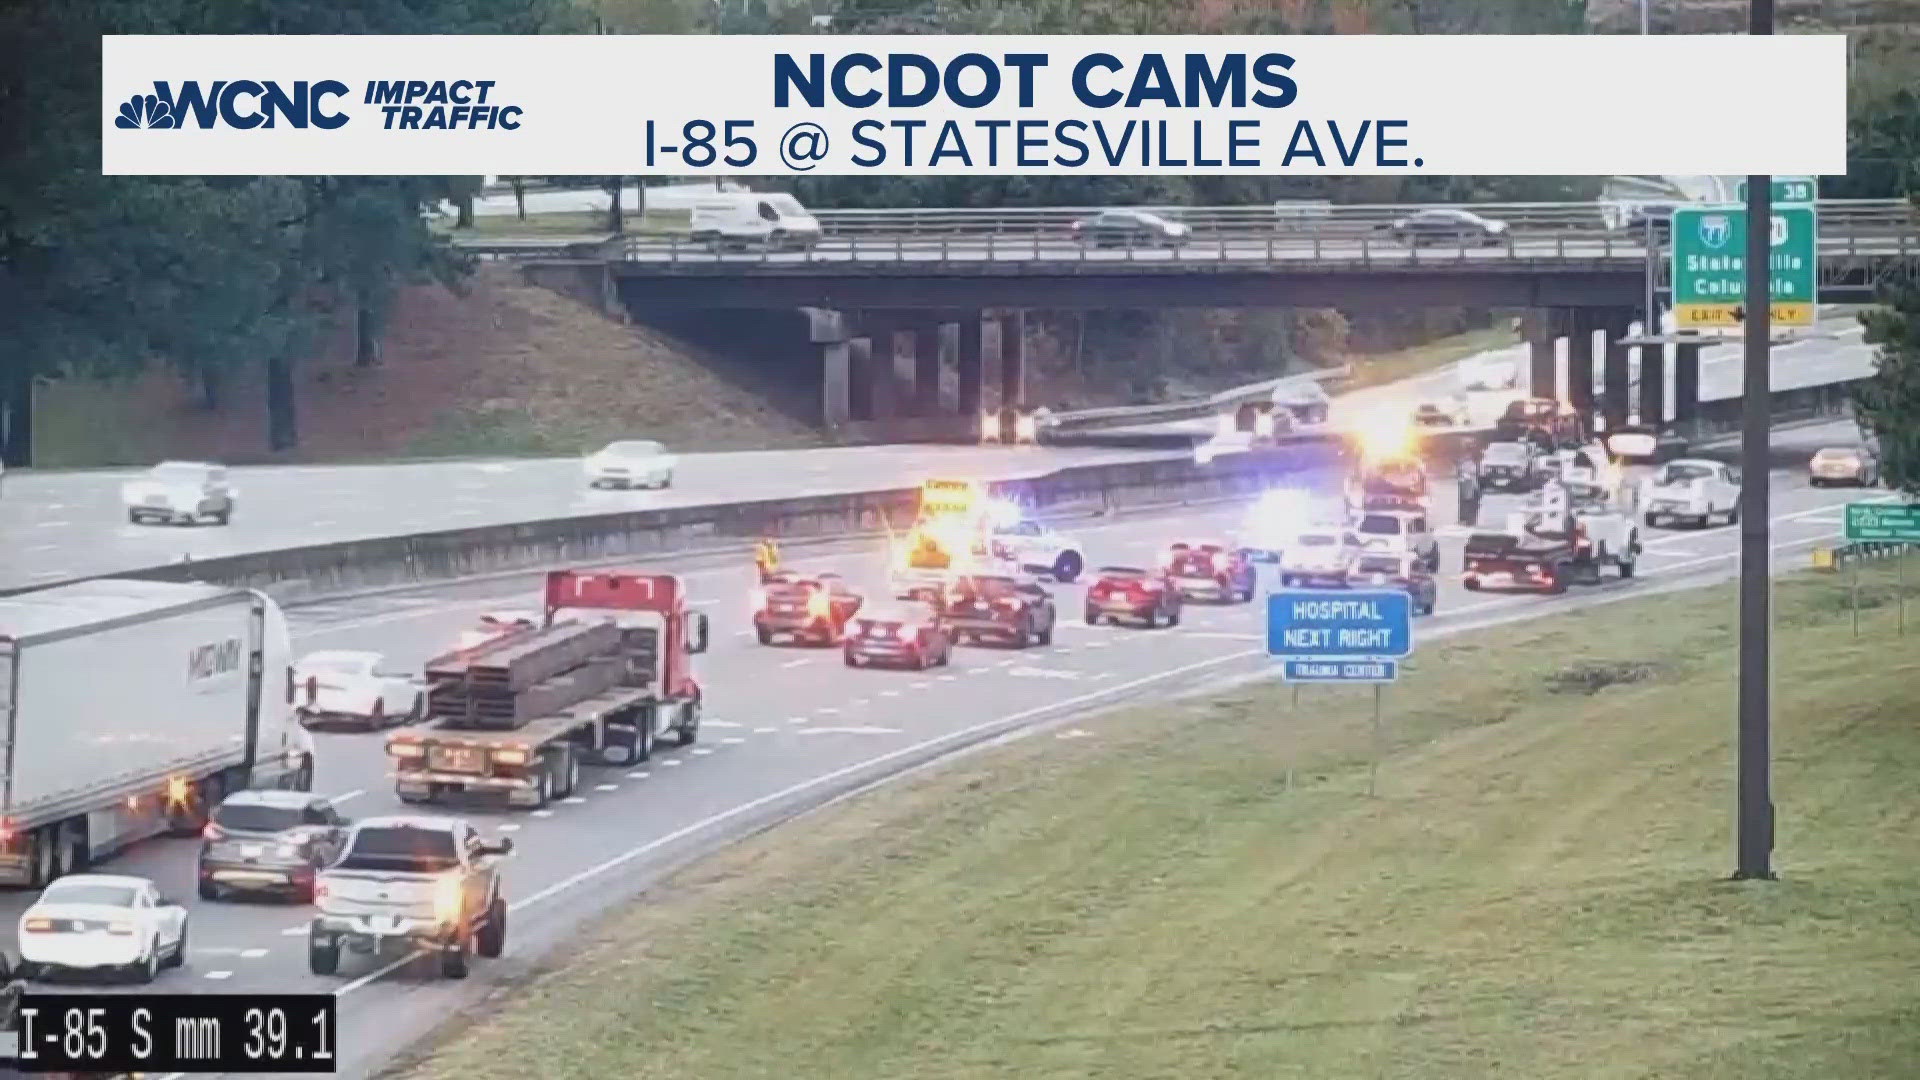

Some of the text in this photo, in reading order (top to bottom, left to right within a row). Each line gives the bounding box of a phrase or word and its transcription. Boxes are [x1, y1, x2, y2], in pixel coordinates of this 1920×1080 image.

[1293, 600, 1384, 620] HOSPITAL
[1284, 628, 1392, 648] NEXT RIGHT
